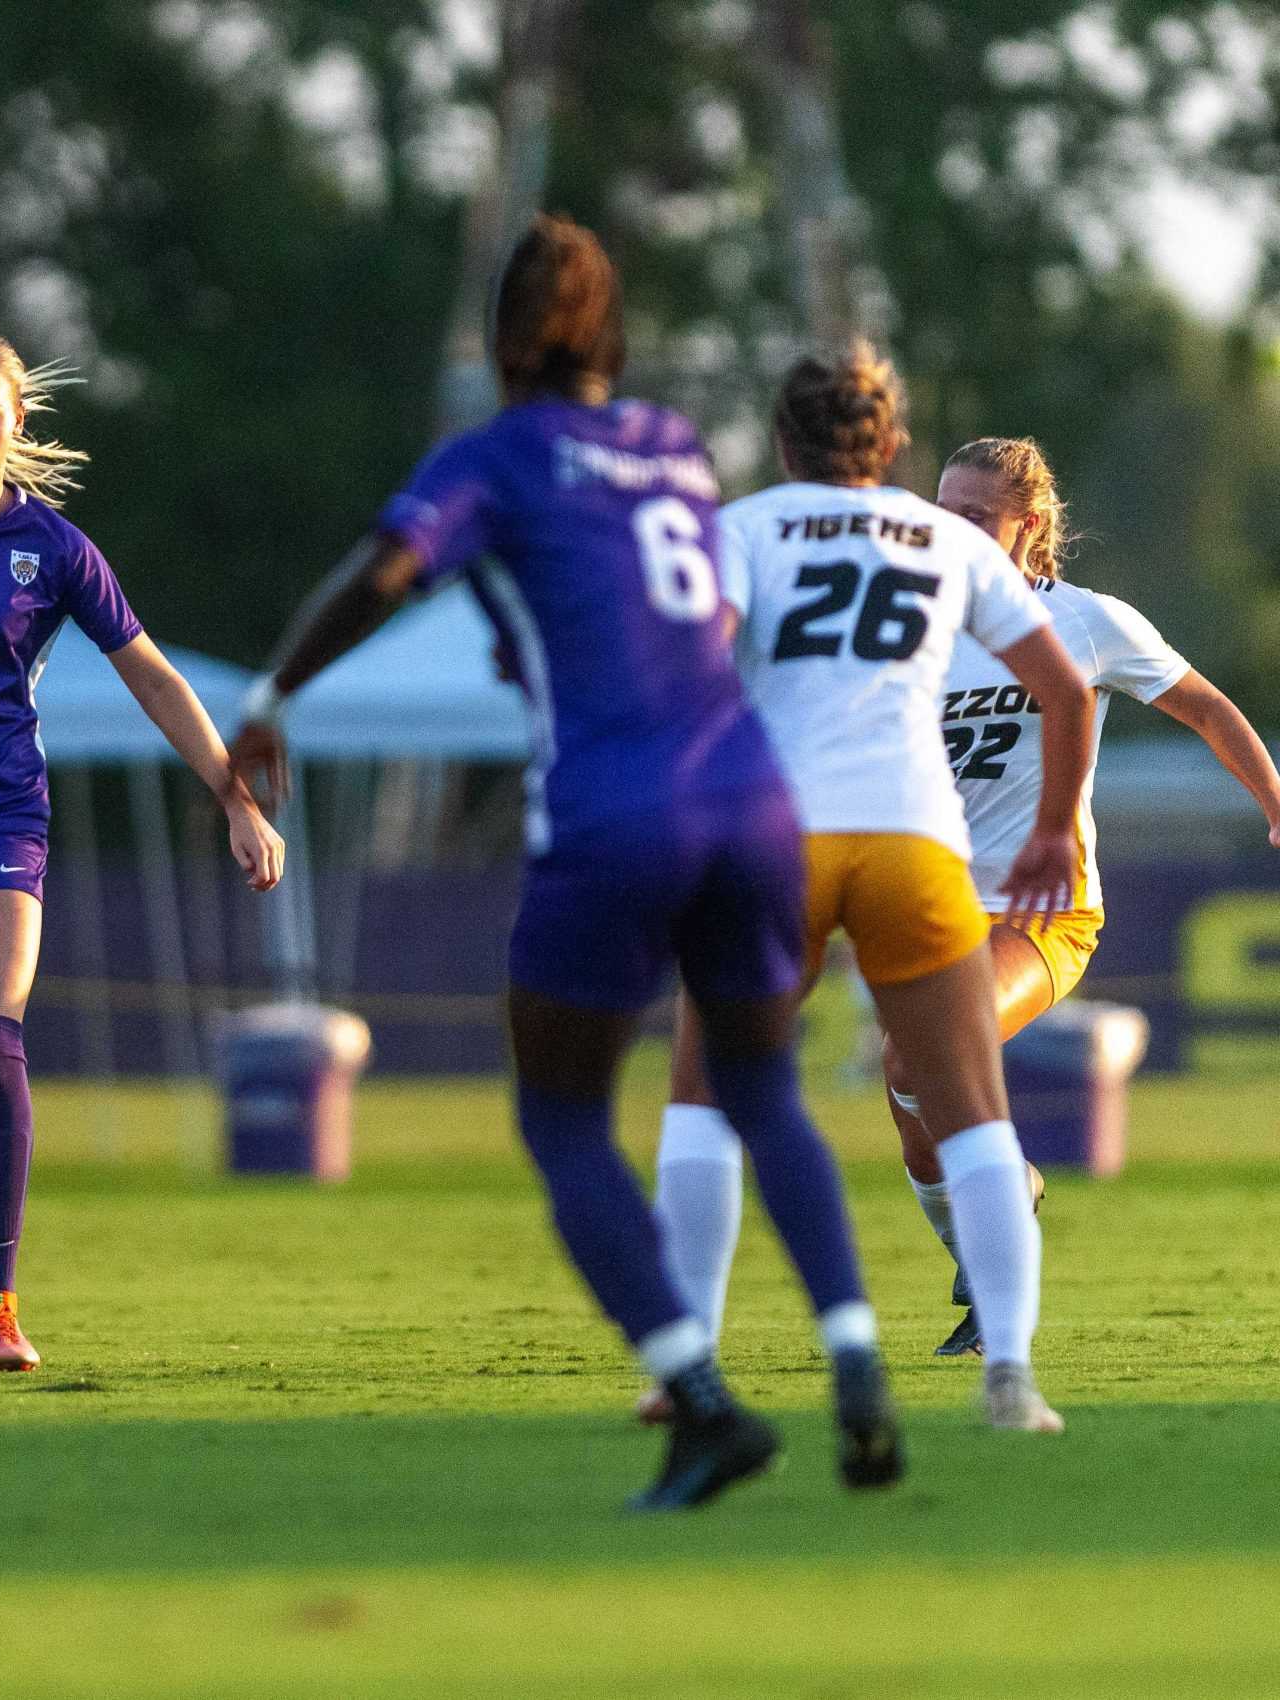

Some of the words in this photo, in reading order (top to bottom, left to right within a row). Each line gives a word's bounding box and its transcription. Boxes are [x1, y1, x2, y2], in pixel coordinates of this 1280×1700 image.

[633, 496, 719, 621] 6
[778, 511, 933, 549] TIGERS
[773, 558, 943, 664] 26
[942, 722, 1022, 780] 22
